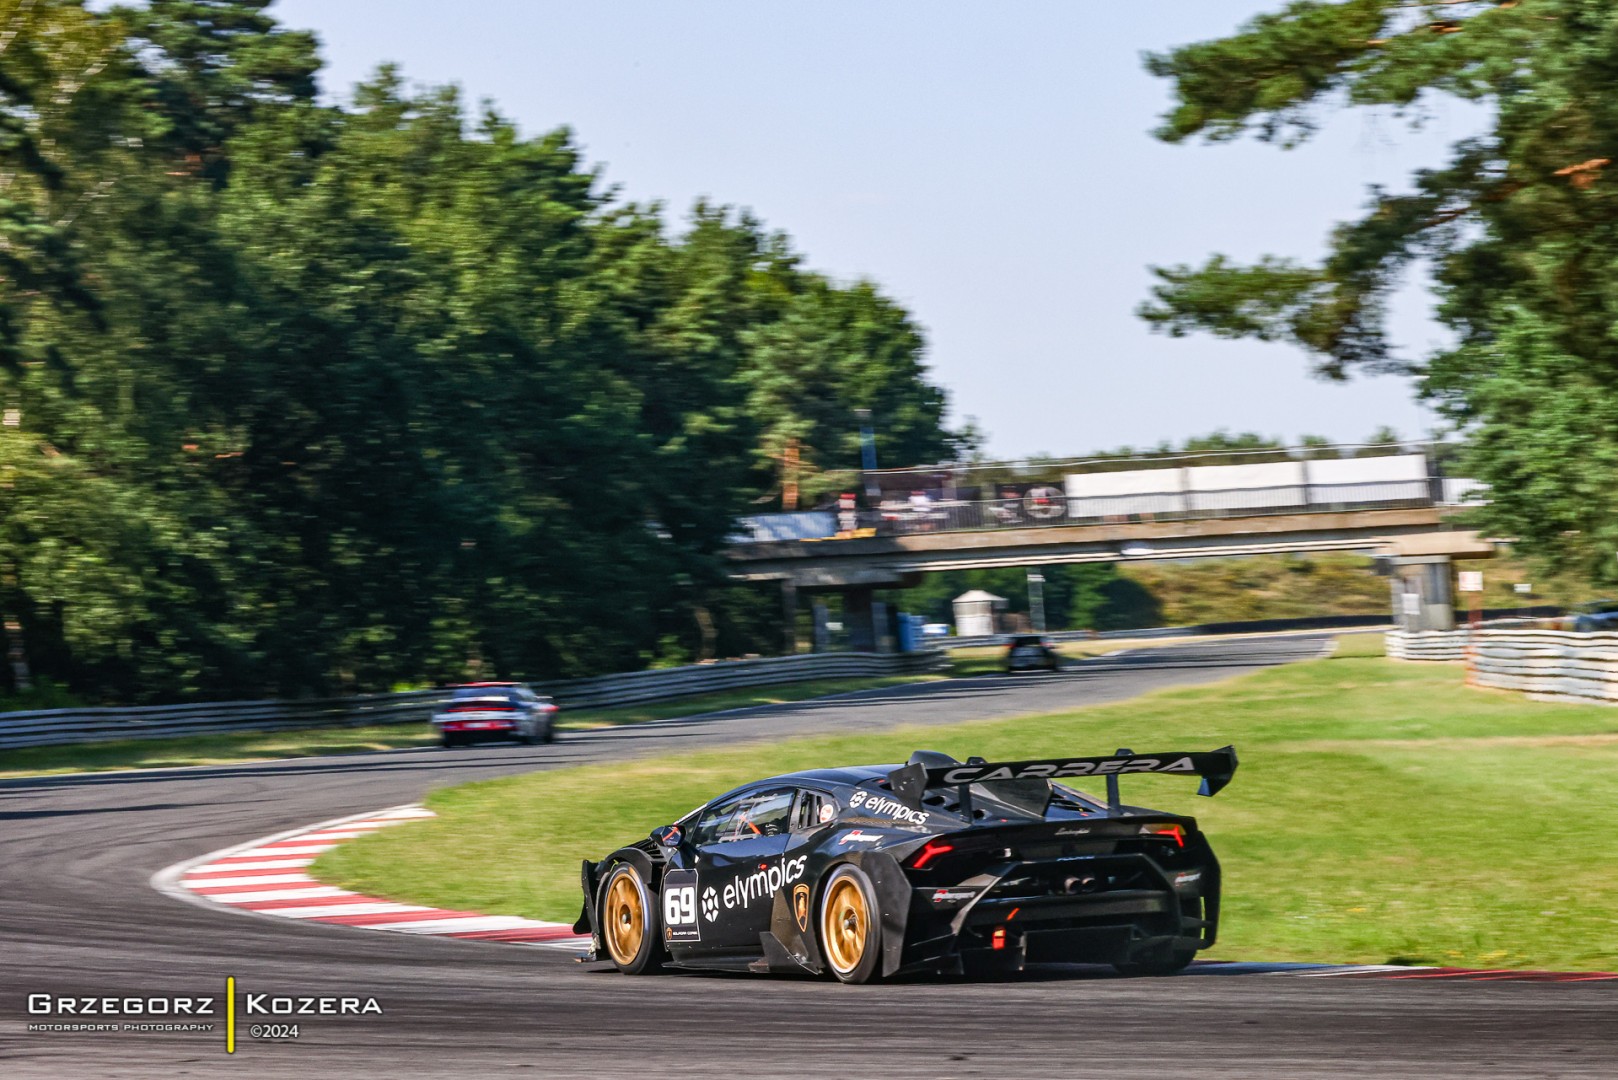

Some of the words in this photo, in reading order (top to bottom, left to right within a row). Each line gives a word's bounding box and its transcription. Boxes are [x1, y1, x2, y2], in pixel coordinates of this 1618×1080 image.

[943, 756, 1195, 784] CARRERA
[864, 796, 930, 825] elympics
[723, 853, 808, 909] elympics
[665, 886, 696, 925] 69
